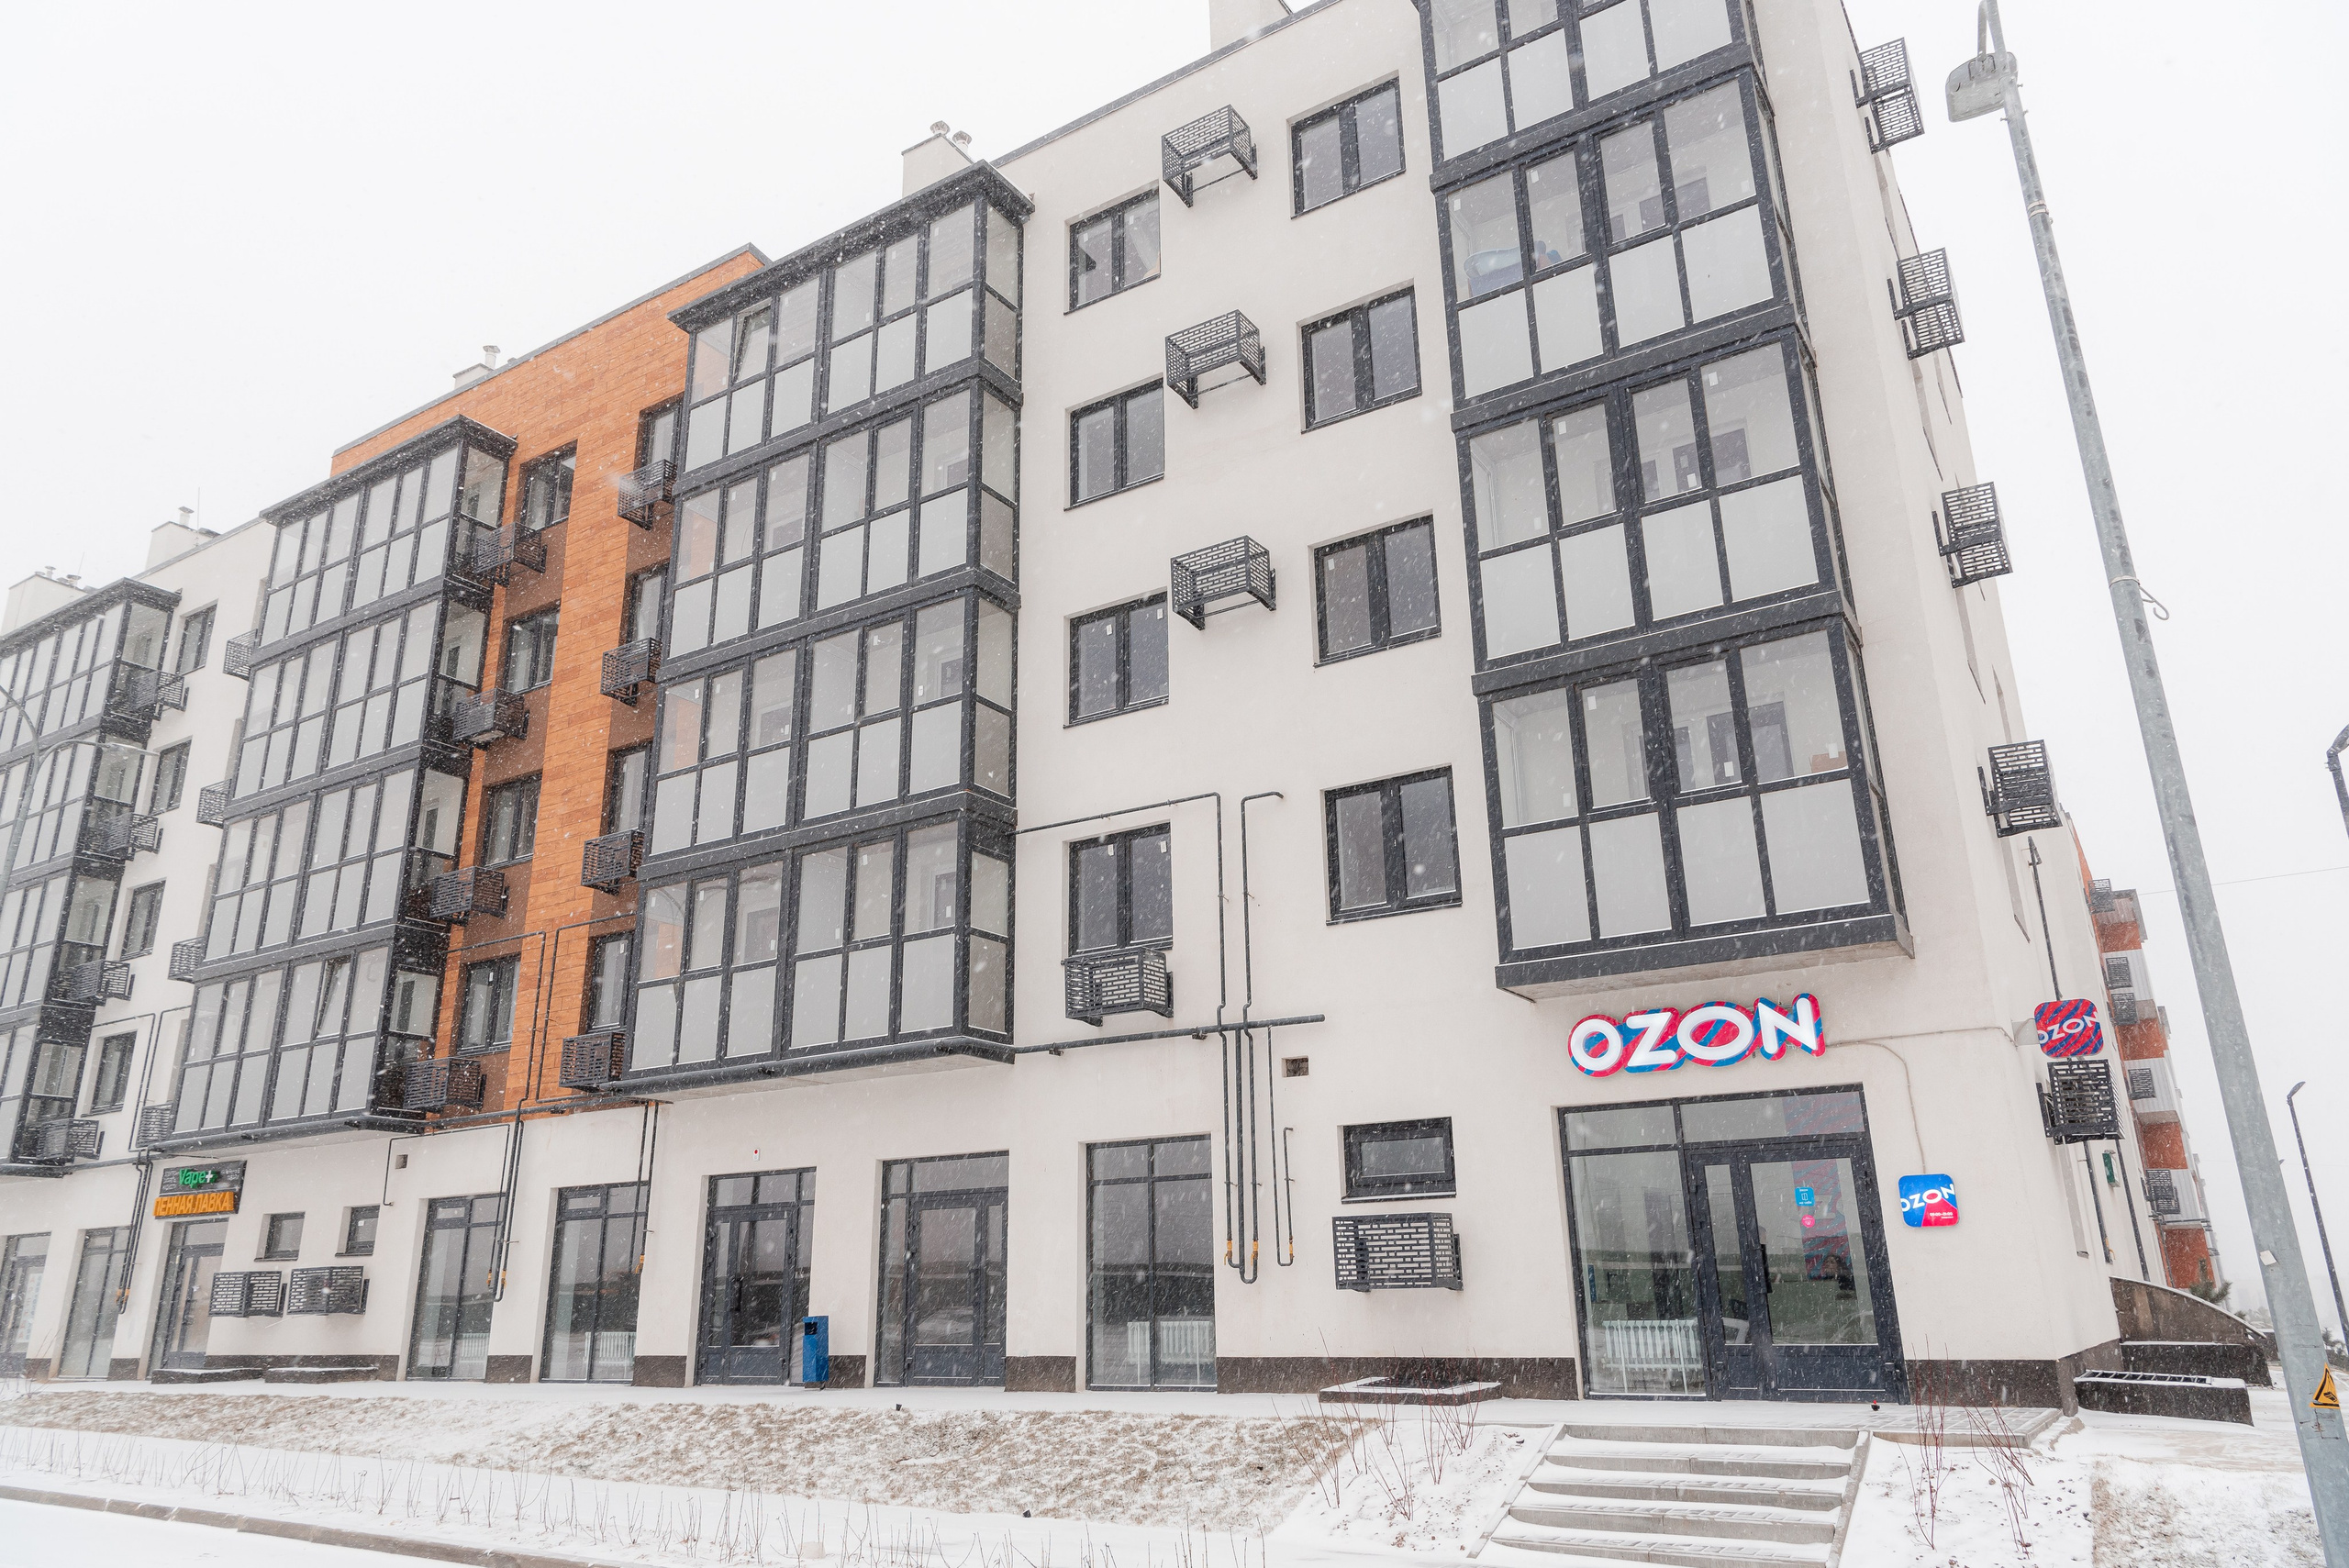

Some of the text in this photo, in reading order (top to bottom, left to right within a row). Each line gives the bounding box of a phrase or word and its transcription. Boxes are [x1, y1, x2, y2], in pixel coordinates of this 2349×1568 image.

[1570, 997, 1818, 1072] OZON
[154, 1191, 230, 1216] ПЕННАЯ ЛАВКА
[1900, 1184, 1955, 1212] OZON
